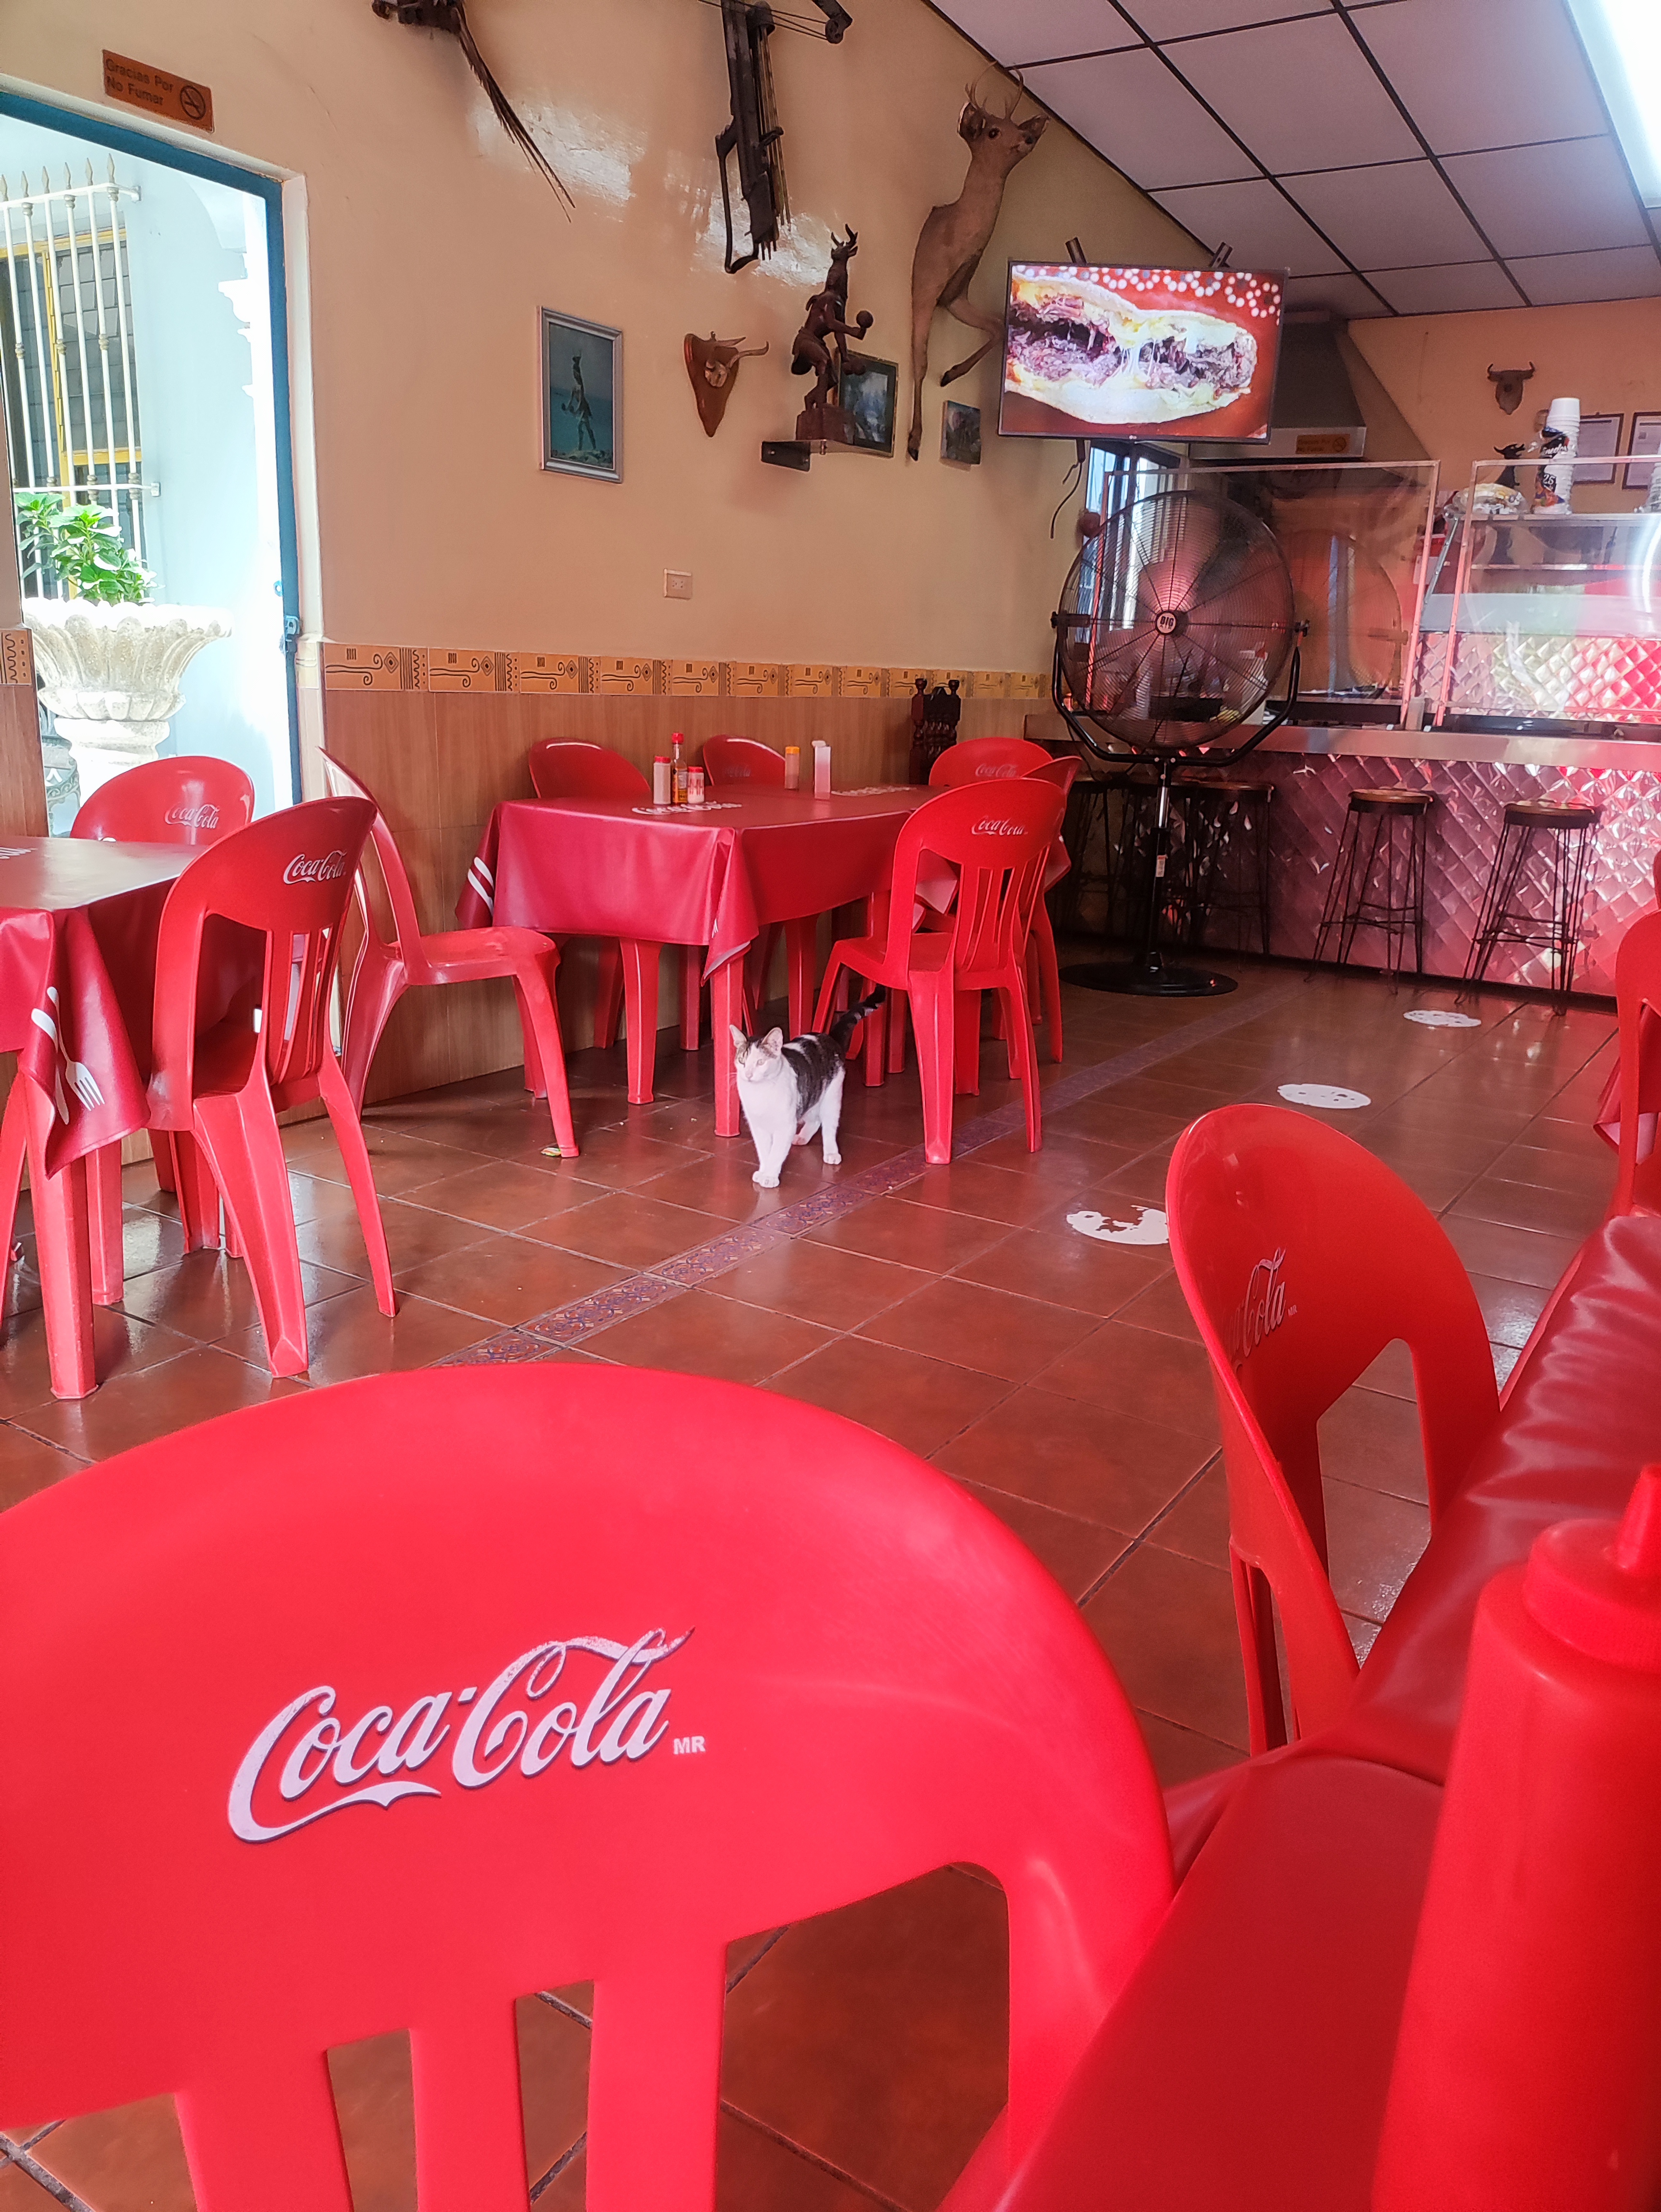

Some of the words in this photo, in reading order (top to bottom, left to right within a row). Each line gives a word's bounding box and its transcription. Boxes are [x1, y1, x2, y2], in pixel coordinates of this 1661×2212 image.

[106, 58, 150, 84] Gracias
[155, 75, 174, 92] Por
[107, 76, 123, 91] No
[128, 83, 164, 105] Fumar
[165, 802, 221, 829] Coca-Cola
[283, 850, 347, 884] Coca-Cola
[227, 1626, 695, 1843] Coca-Cola
[674, 1736, 706, 1755] MR
